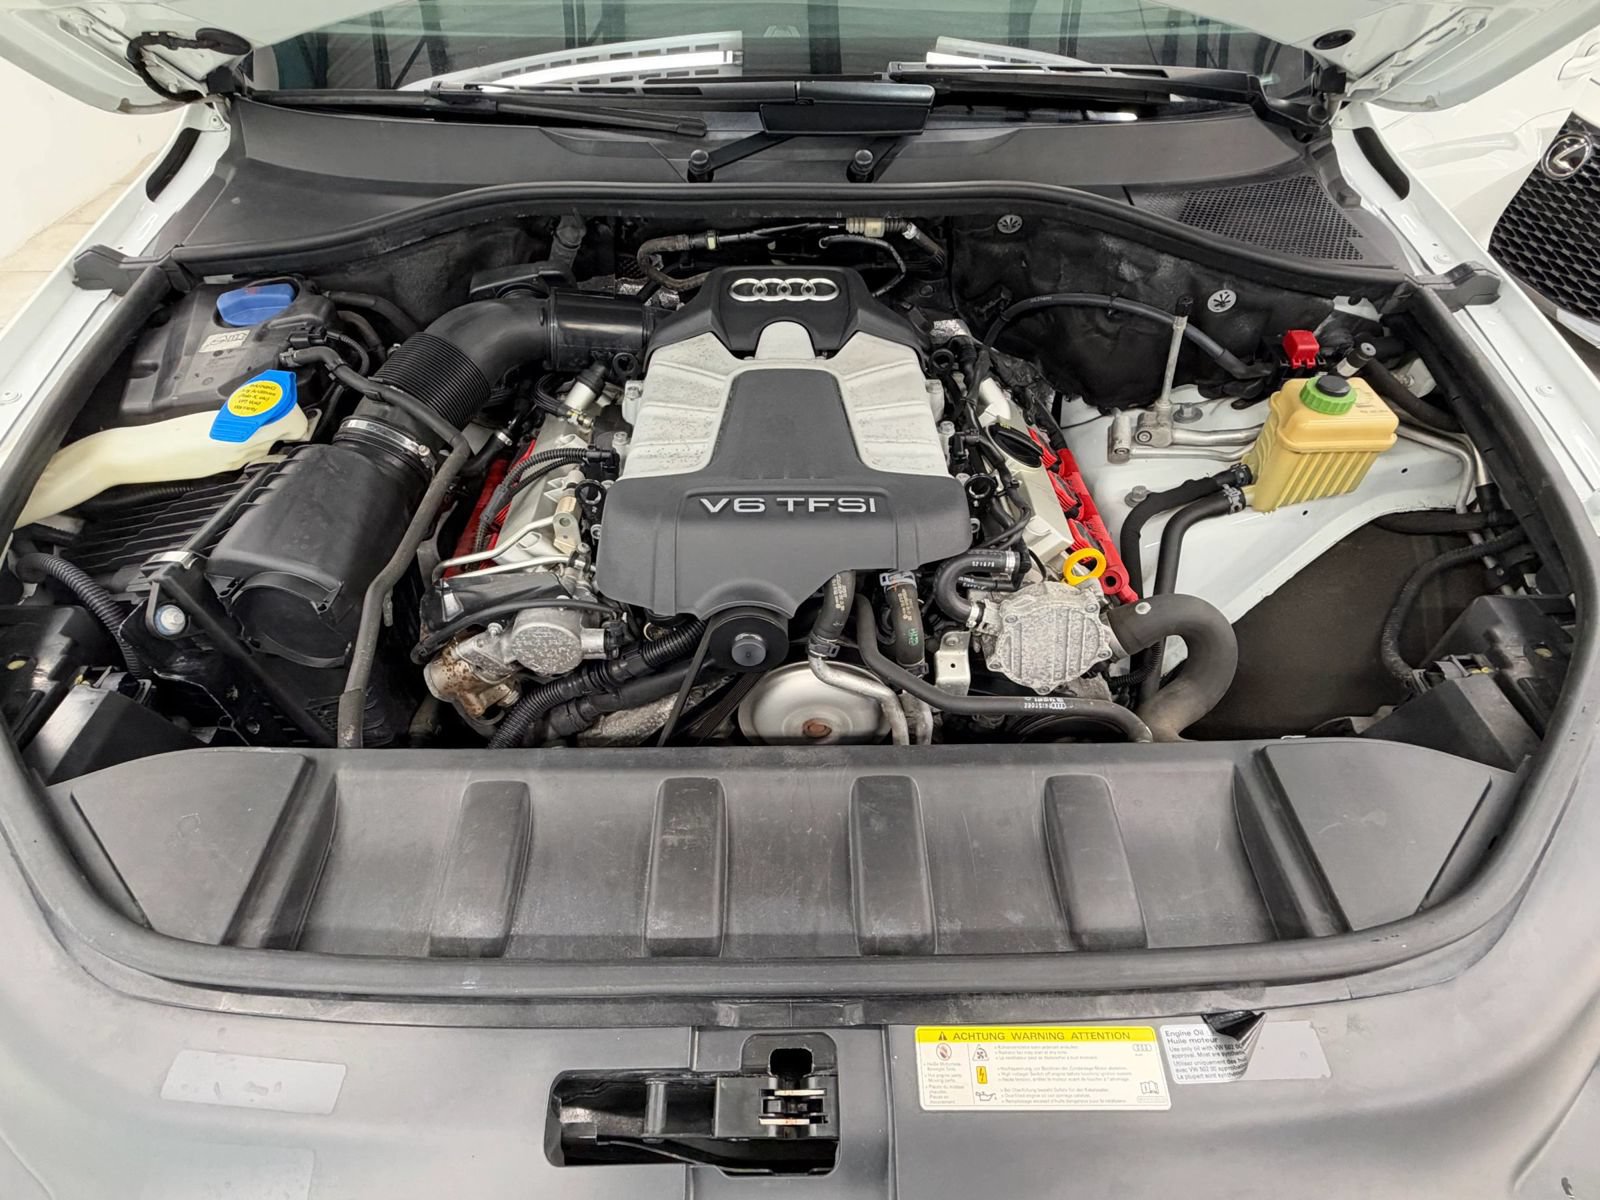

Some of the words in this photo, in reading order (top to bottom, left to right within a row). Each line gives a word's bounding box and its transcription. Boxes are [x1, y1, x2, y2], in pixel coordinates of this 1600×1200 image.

[699, 497, 766, 513] V6
[776, 497, 876, 513] TFSI
[953, 1031, 1005, 1041] ACHTUNG
[1011, 1031, 1065, 1041] WARNING
[1071, 1031, 1131, 1040] ATTENTION
[1165, 1030, 1192, 1038] Engine
